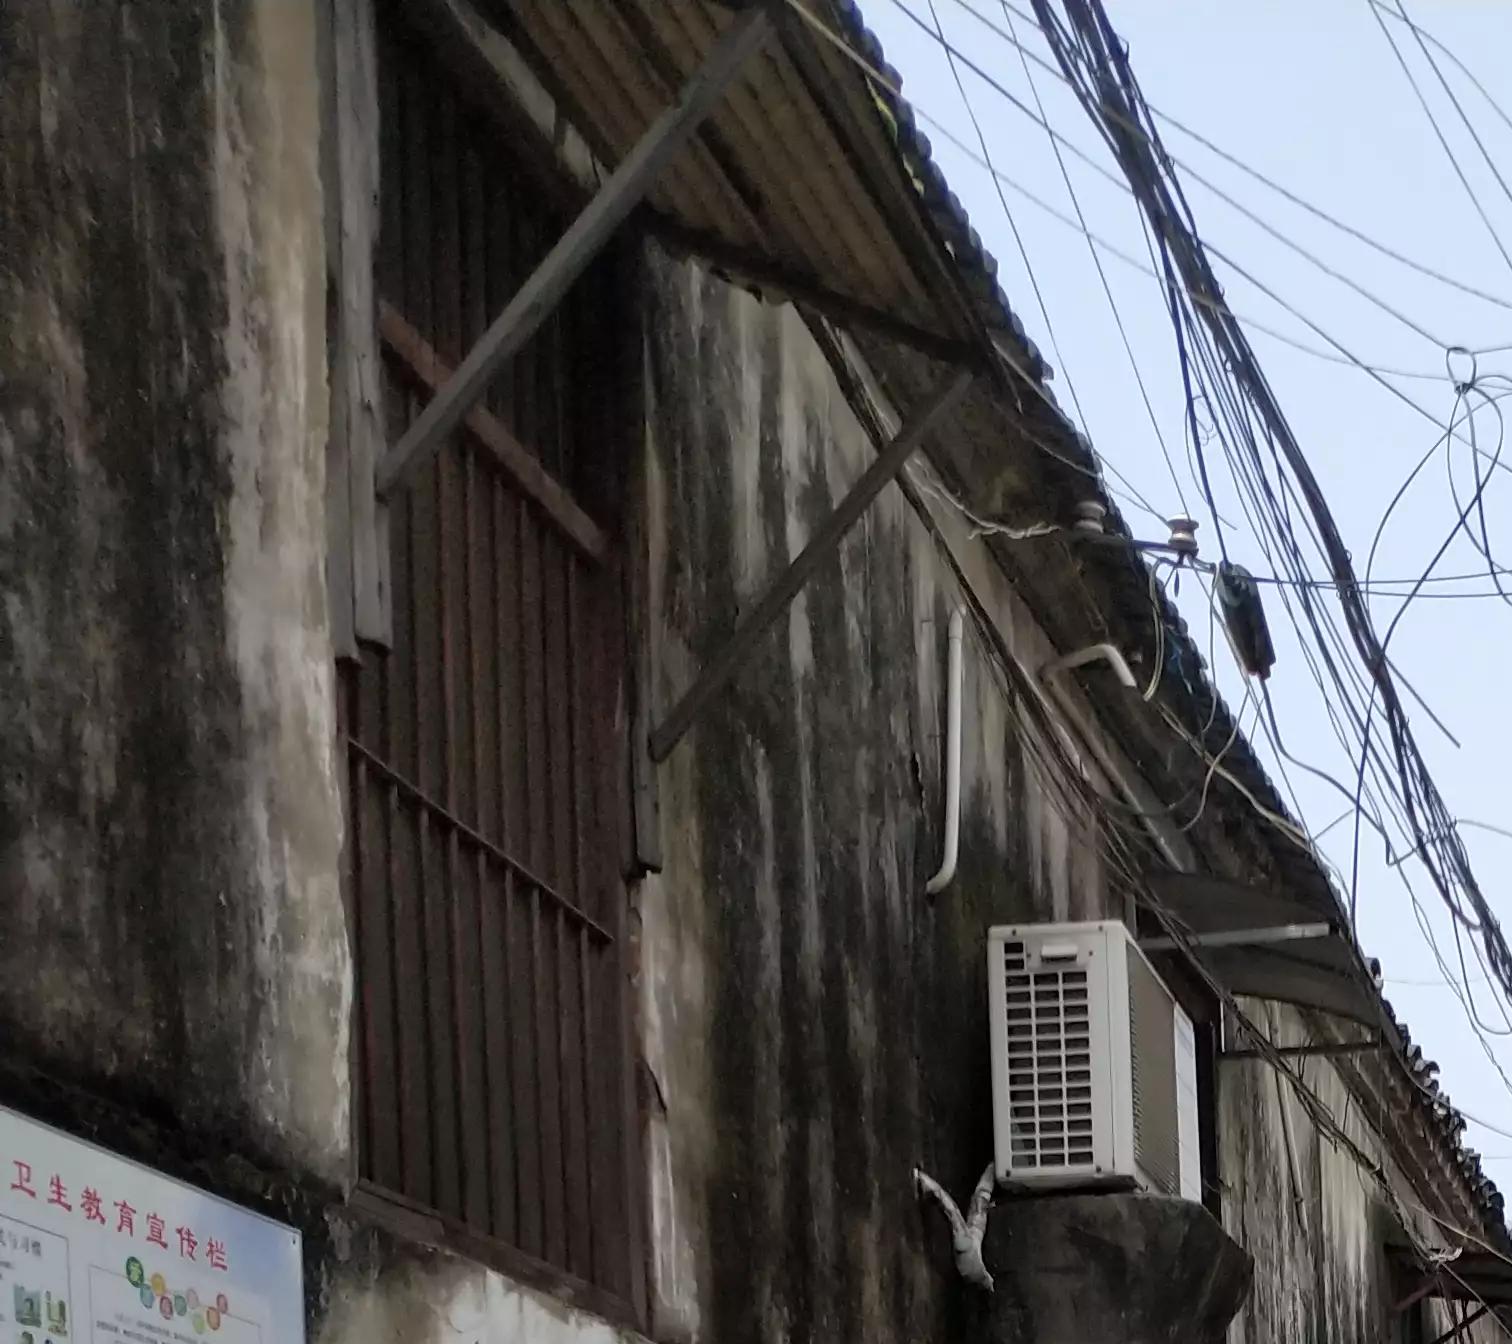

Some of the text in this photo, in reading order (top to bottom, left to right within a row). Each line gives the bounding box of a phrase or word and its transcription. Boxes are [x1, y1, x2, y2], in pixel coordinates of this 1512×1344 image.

[10, 1159, 228, 1271] 卫生教育宣传栏
